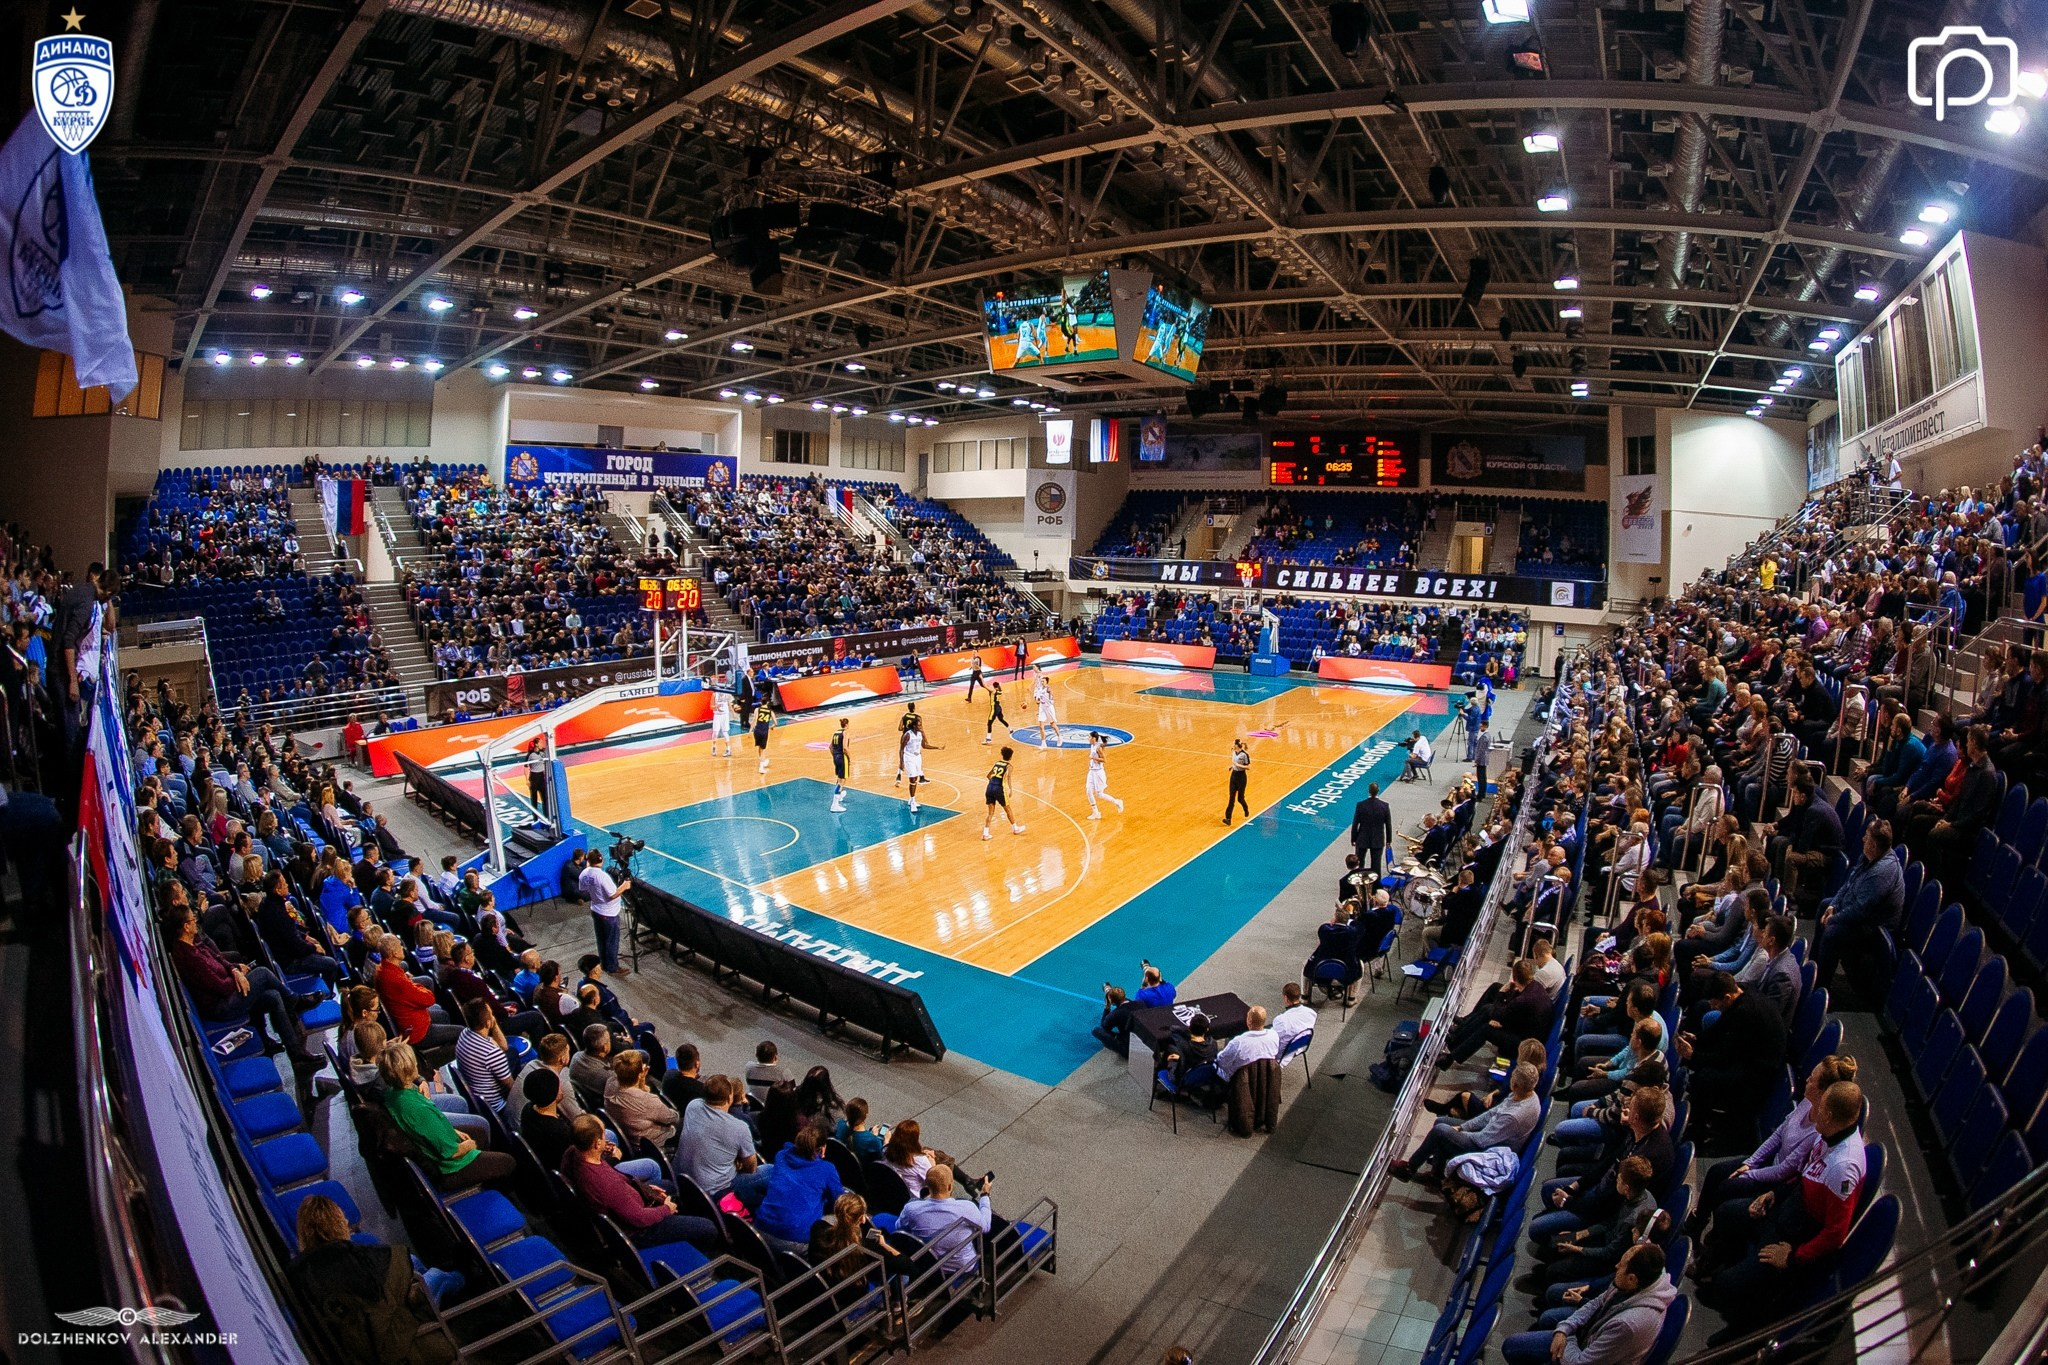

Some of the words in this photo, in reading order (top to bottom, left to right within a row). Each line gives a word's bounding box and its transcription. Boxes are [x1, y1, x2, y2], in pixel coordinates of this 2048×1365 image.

[1875, 411, 1945, 457] Металлоинвест
[606, 455, 652, 473] ГОРОД
[1325, 462, 1353, 472] 06:35
[1486, 460, 1526, 470] КУРСКОЙ
[1527, 462, 1567, 472] ОБЛАСТИ
[544, 472, 637, 487] УСТРЕМЛЕННЫЙ
[641, 476, 649, 486] В
[652, 477, 705, 489] БУДУЩЕЕ!
[1037, 515, 1063, 525] РФБ
[1160, 565, 1199, 581] МЫ
[1277, 569, 1399, 593] СИЛЬНЕЕ
[1415, 576, 1498, 599] ВСЕХ!
[646, 591, 661, 609] 20
[677, 590, 698, 608] 20
[901, 634, 939, 647] @russiabasket
[748, 650, 791, 662] ЕМПИОНАТ
[791, 646, 823, 658] РОССИИ
[615, 666, 675, 683] @russiabaket
[456, 687, 490, 707] РФБ
[620, 687, 654, 698] GARED
[758, 712, 770, 723] 24
[991, 766, 1004, 778] 32
